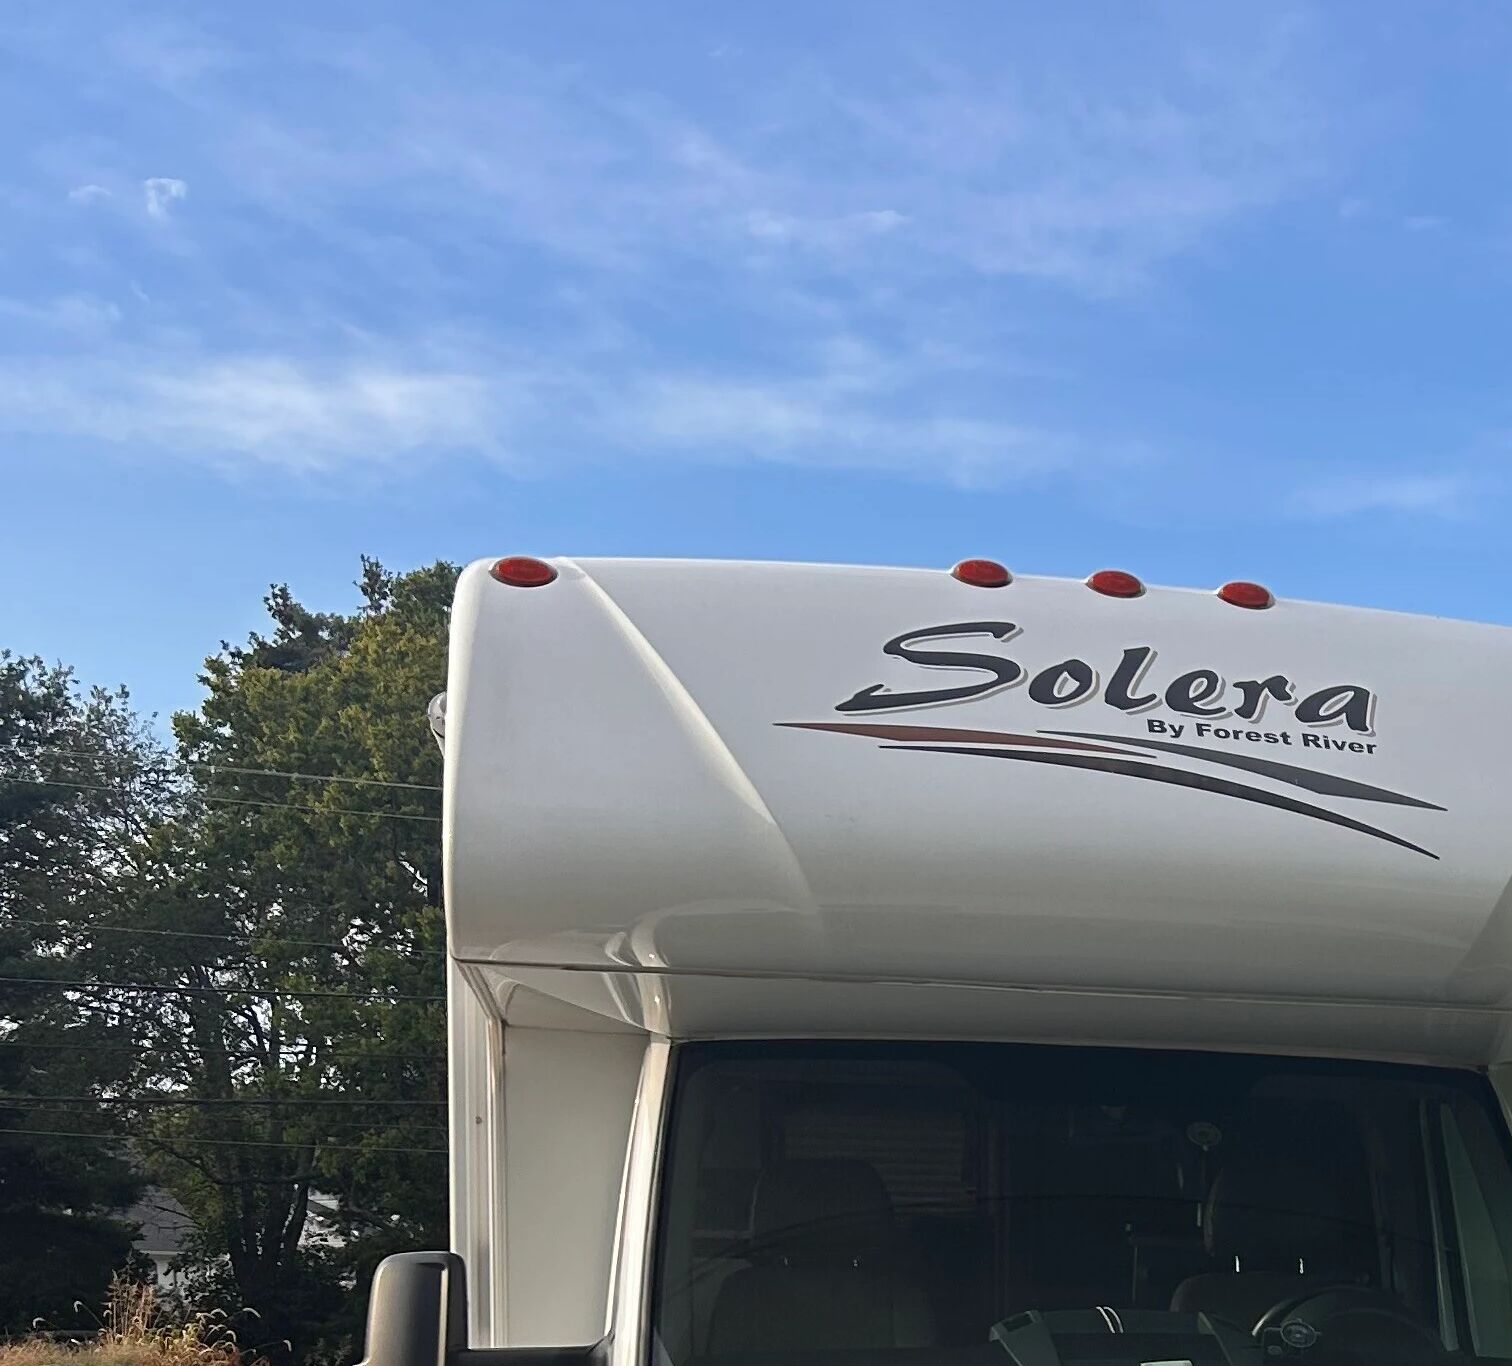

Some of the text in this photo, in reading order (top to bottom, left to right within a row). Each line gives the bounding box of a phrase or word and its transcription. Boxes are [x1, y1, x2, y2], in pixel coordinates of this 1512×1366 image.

[835, 621, 1378, 735] Solera
[1147, 718, 1377, 755] By Forest River
